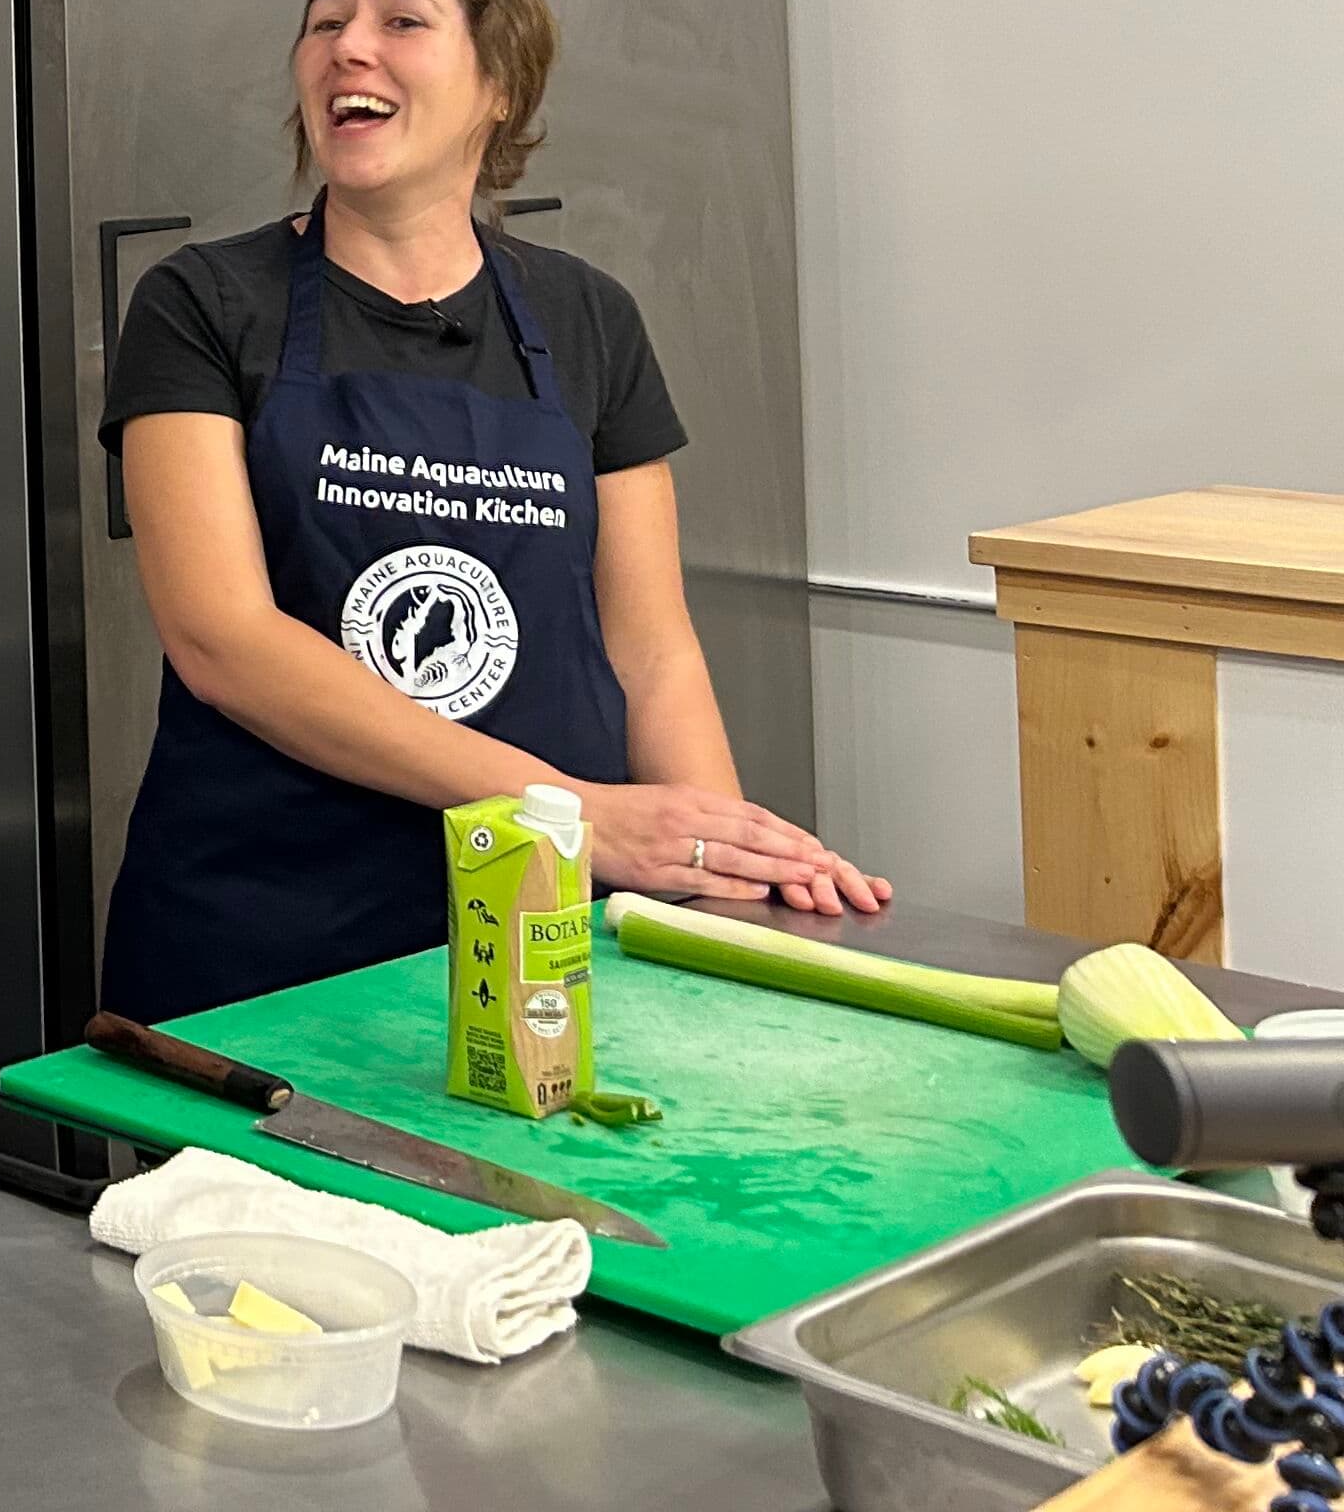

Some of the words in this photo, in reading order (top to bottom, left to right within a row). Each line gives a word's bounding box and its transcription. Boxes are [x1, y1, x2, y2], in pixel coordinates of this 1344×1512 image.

[320, 443, 407, 476] Maine
[411, 454, 567, 493] Aquaculture
[317, 477, 469, 521] Innovation
[474, 495, 567, 530] Kitchen
[351, 560, 398, 614] MAINE
[404, 551, 511, 629] AQUACULTURE
[447, 657, 507, 714] CENTER
[529, 919, 579, 942] BOTA
